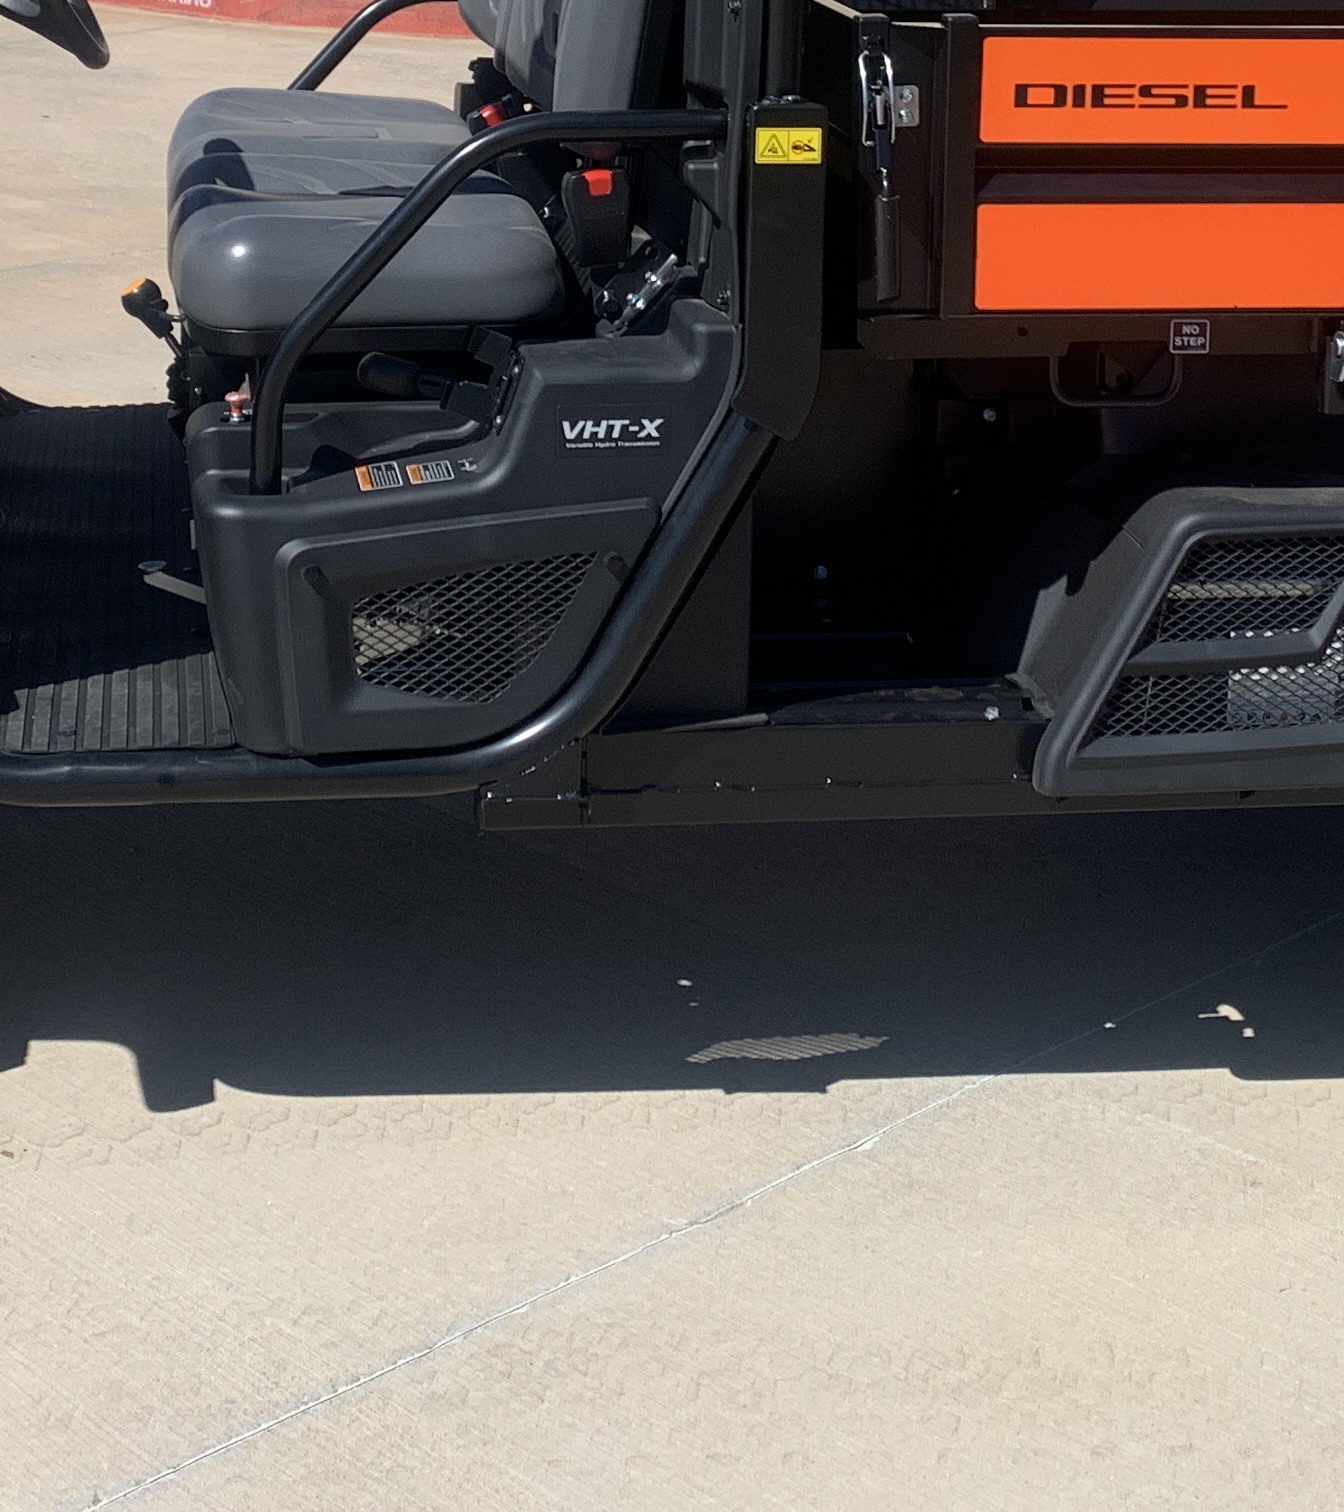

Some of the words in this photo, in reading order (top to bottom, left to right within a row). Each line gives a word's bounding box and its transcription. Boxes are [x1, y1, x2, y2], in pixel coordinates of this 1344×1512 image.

[1013, 83, 1288, 110] DIESEL
[1182, 324, 1200, 335] NO
[1174, 336, 1205, 346] STEP
[562, 418, 665, 440] VHT-X
